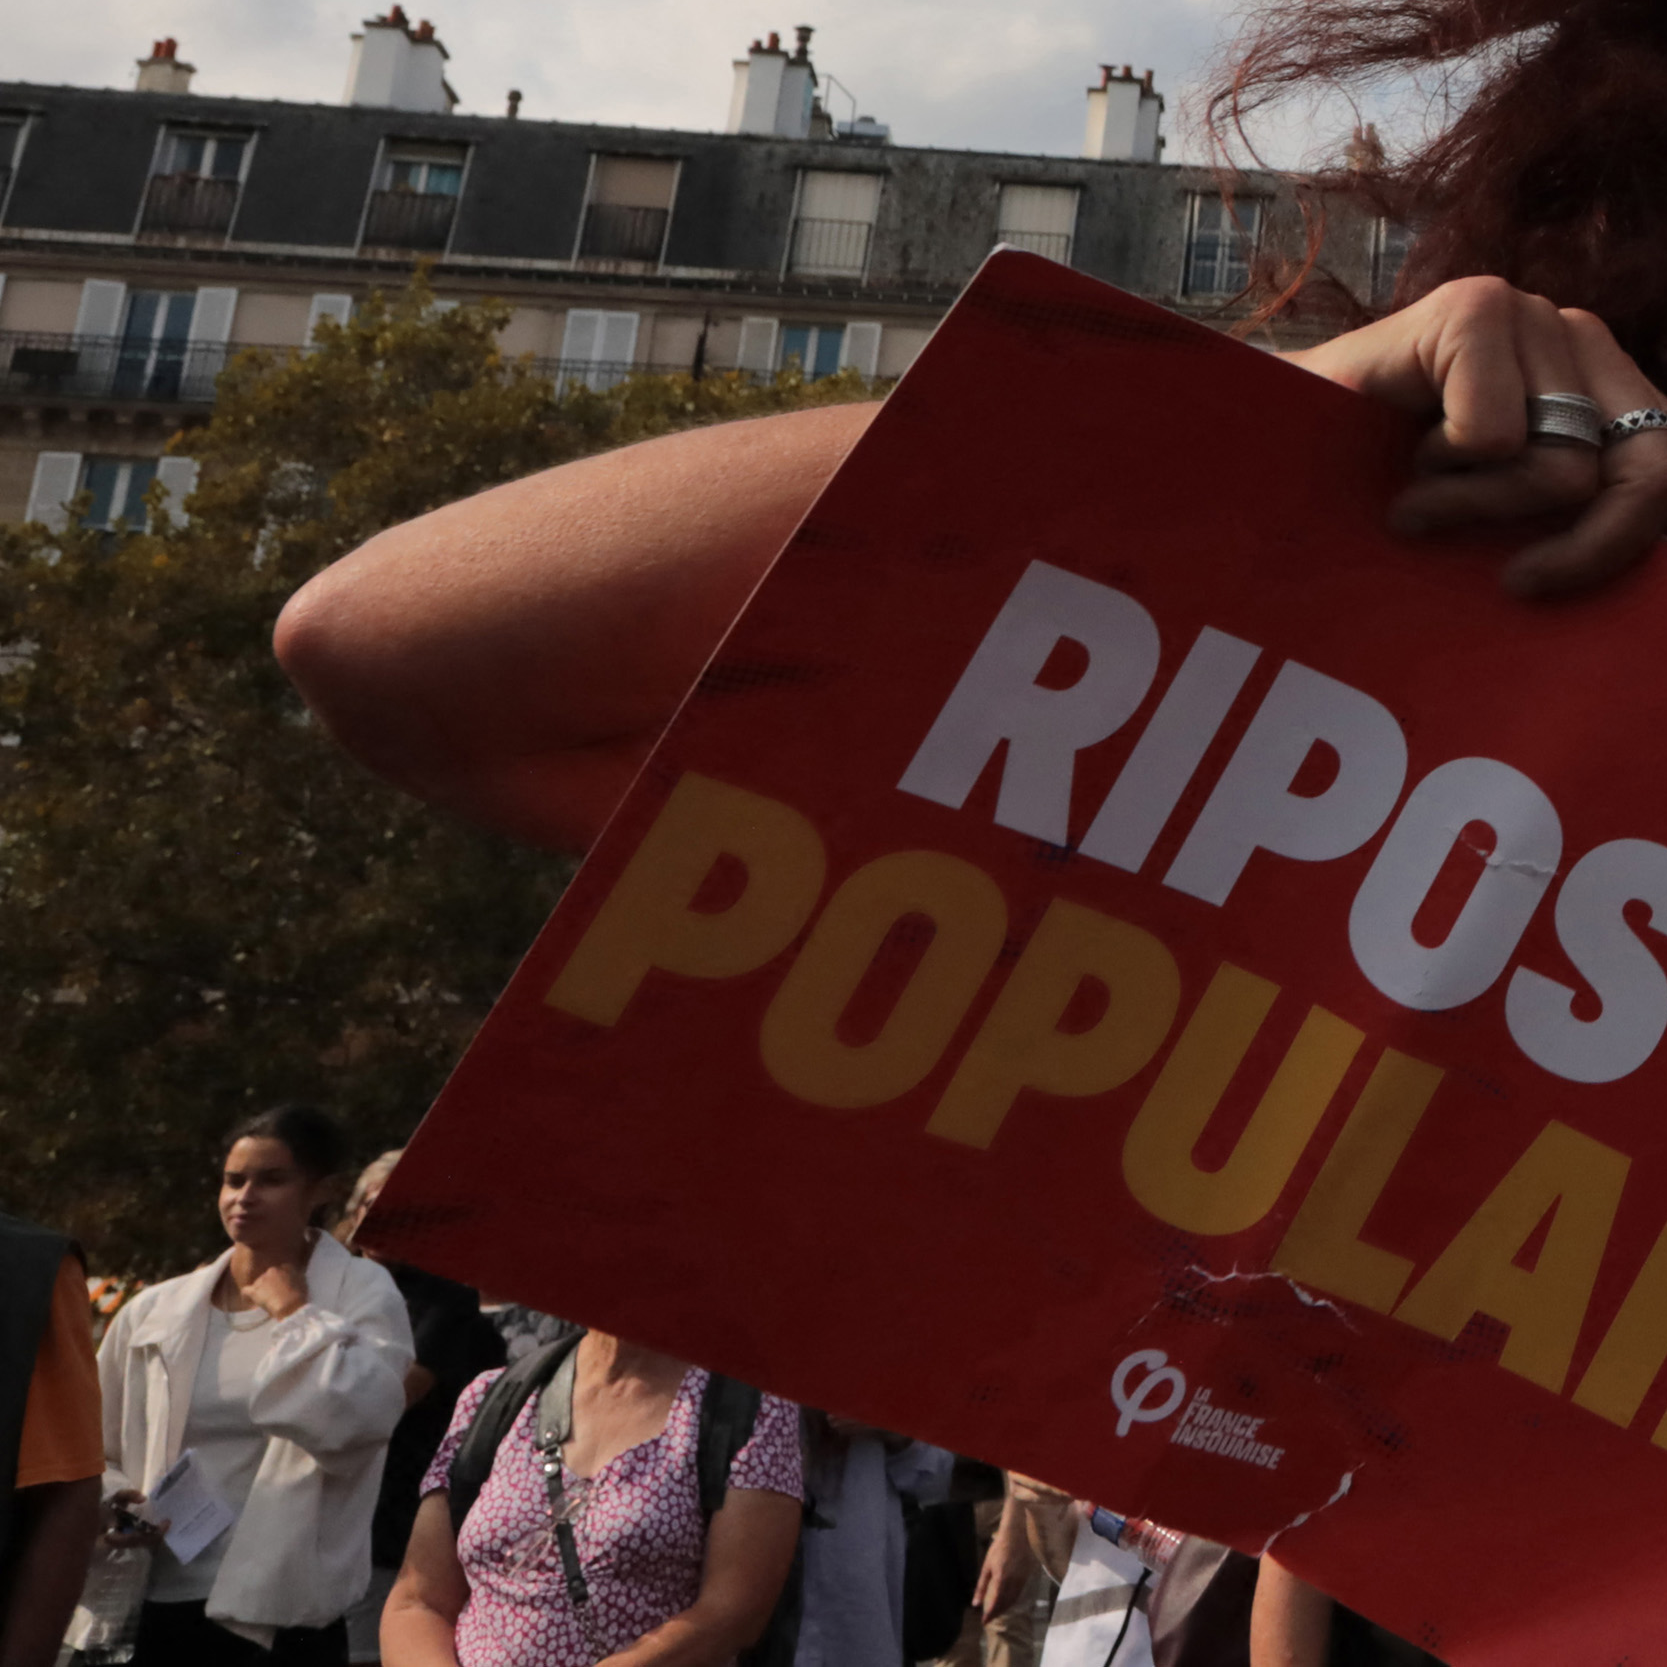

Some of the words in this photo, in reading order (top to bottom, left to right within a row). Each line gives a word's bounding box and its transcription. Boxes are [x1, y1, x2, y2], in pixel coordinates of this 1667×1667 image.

[1194, 1386, 1213, 1403] LA
[1179, 1403, 1266, 1440] FRANCE
[1169, 1425, 1286, 1471] INSOUMISE
